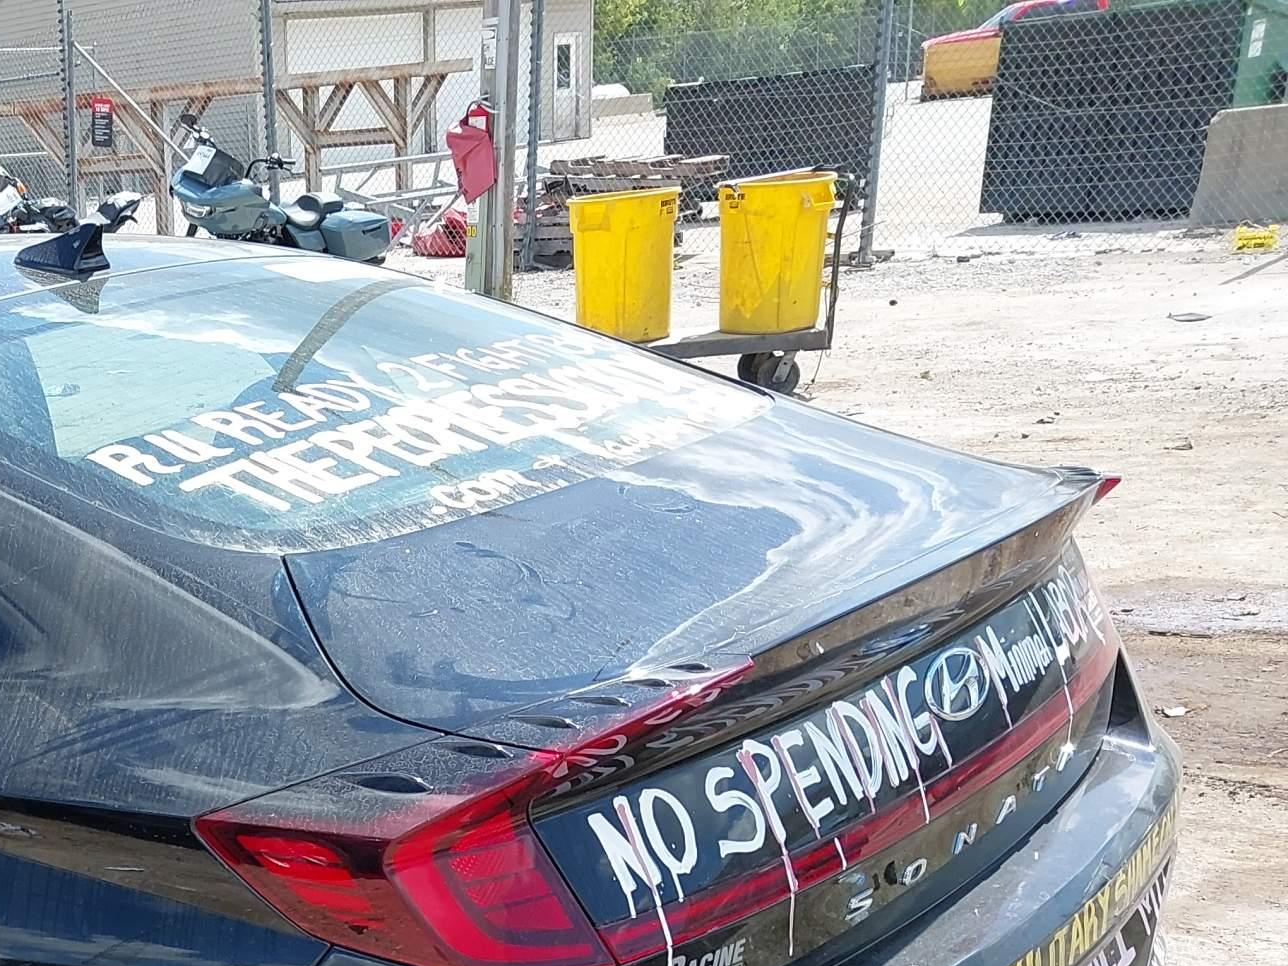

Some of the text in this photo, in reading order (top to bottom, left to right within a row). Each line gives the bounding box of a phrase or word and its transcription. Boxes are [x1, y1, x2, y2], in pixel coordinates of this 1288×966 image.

[376, 362, 454, 392] 2
[411, 334, 550, 380] FIGHT
[189, 371, 409, 445] READY
[84, 444, 185, 486] R
[144, 430, 235, 462] U
[588, 787, 698, 895] NO
[705, 666, 940, 858] SPENDING
[845, 743, 1074, 921] SONATA
